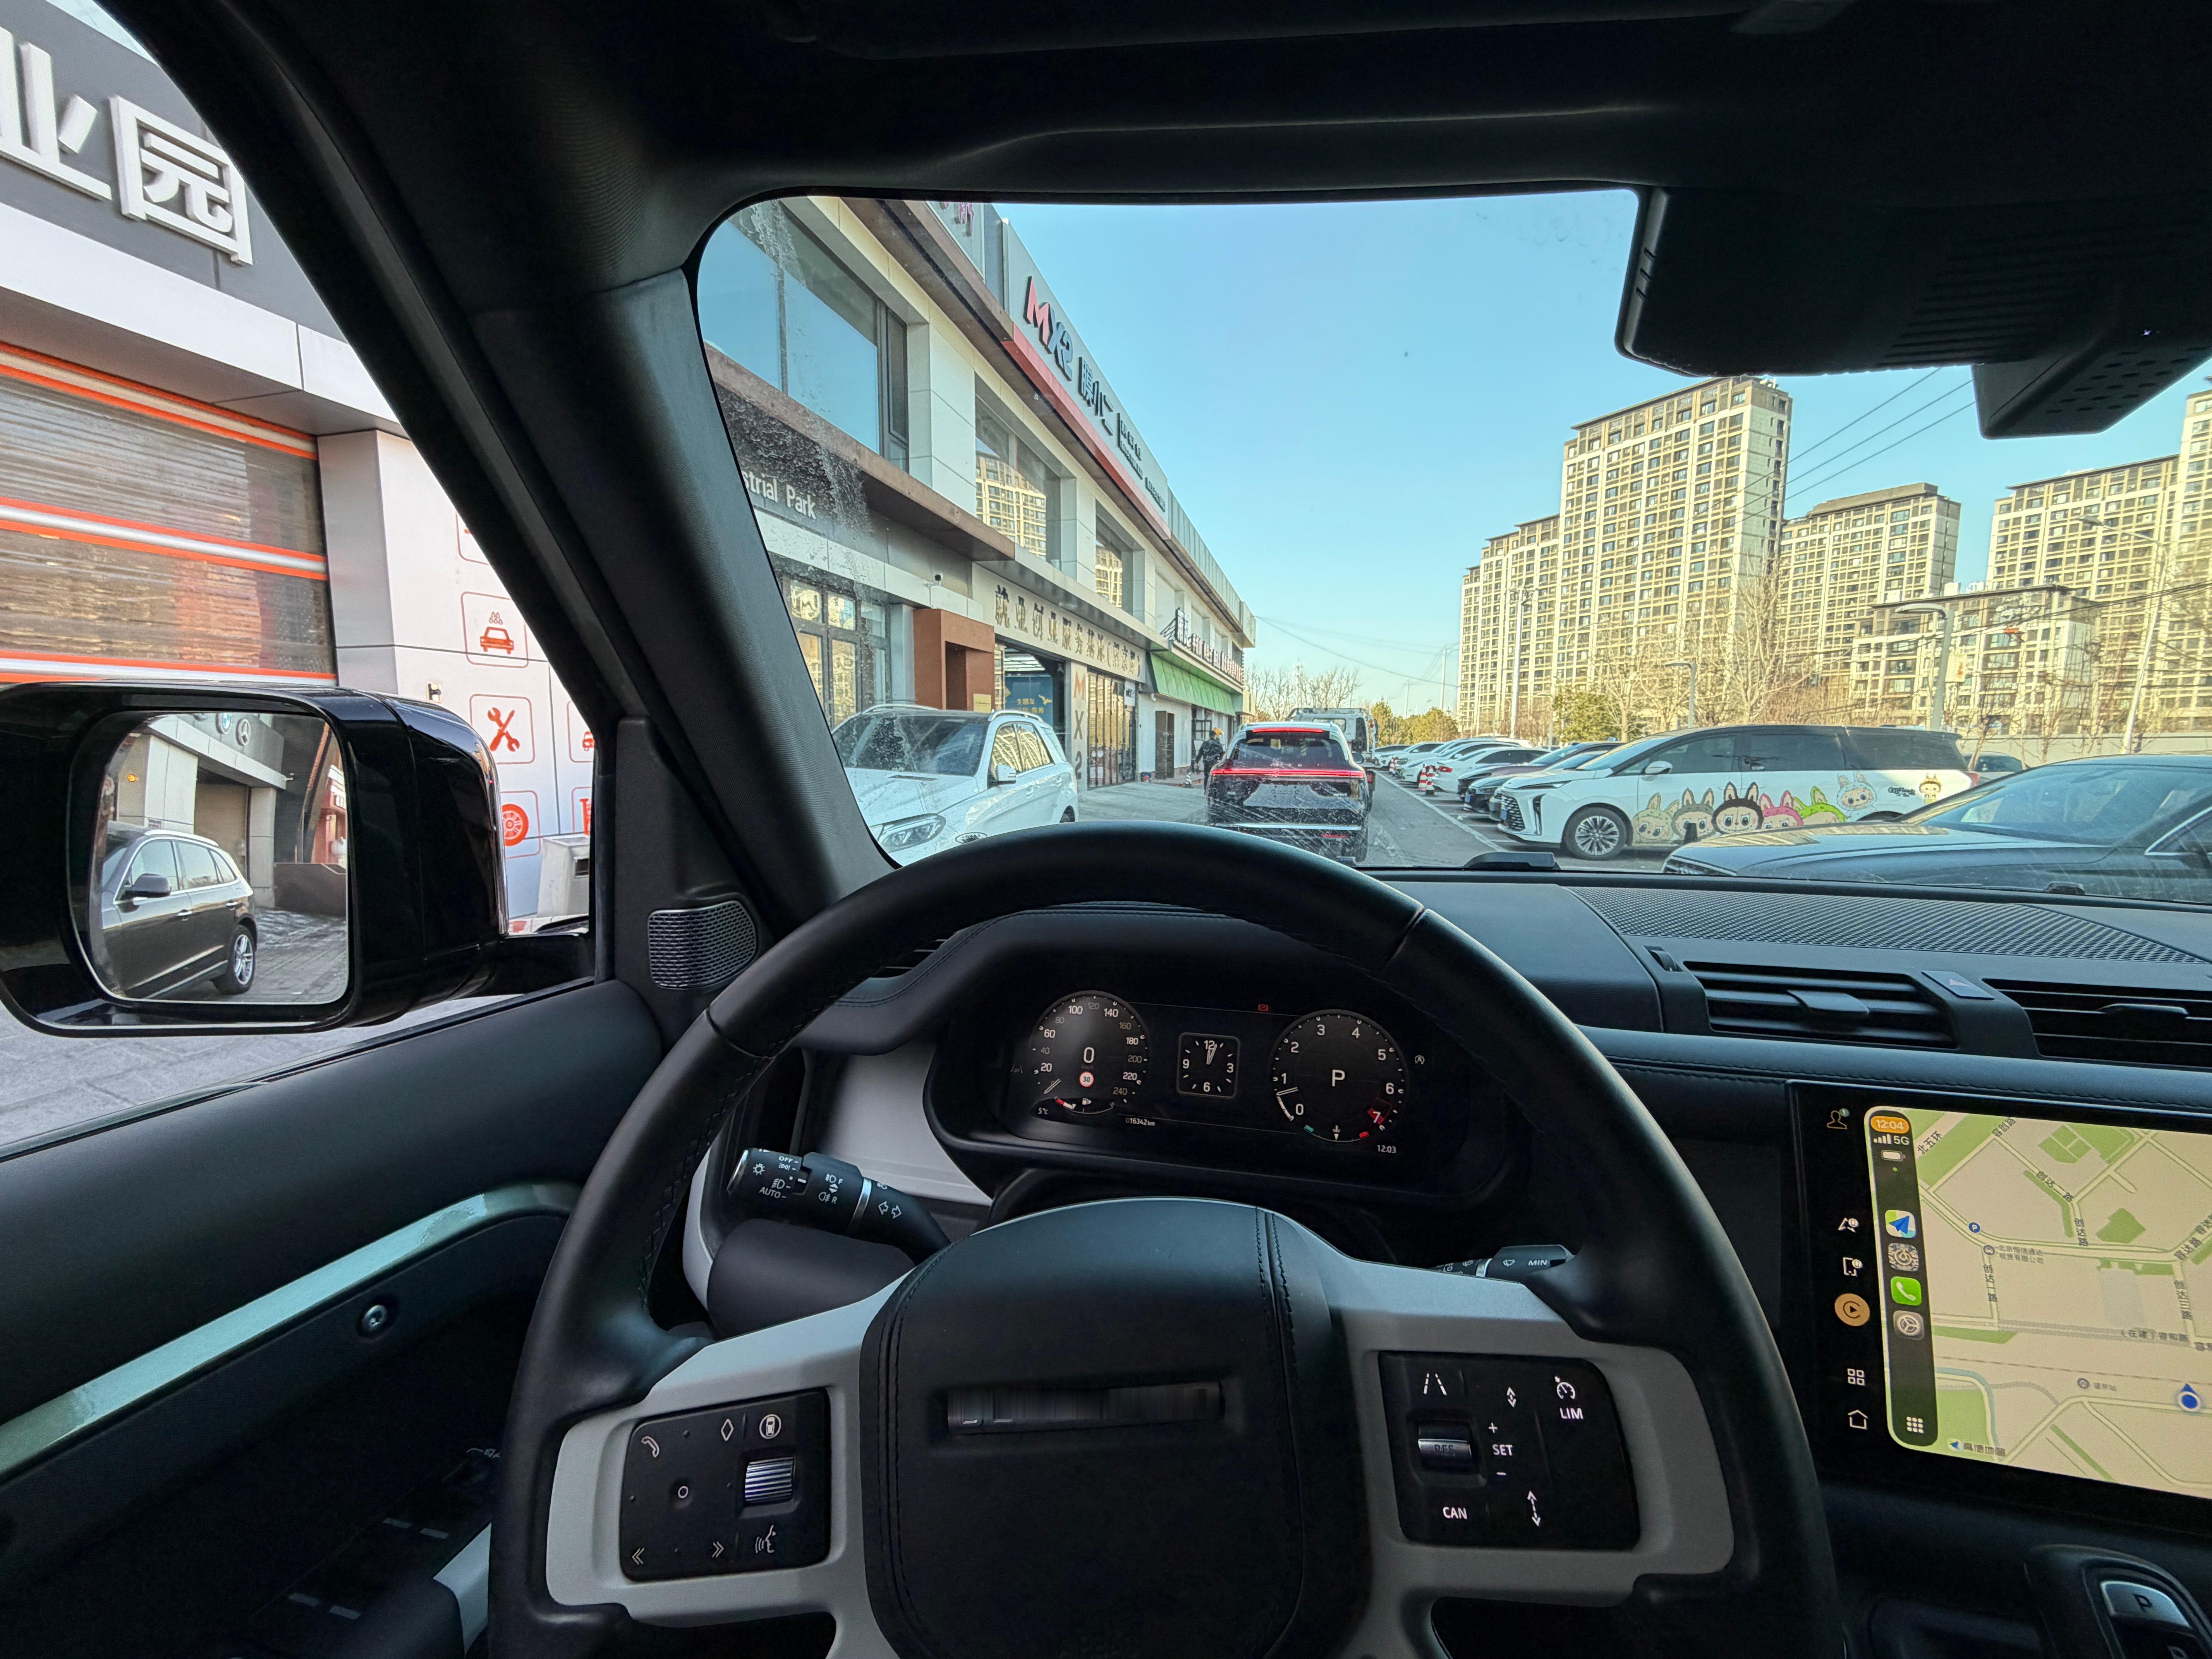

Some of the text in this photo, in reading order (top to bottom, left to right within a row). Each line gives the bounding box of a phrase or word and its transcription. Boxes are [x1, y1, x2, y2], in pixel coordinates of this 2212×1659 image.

[786, 484, 816, 519] Park
[1068, 1005, 1083, 1015] 100
[1104, 1008, 1118, 1018] 140
[1044, 1029, 1056, 1038] 60
[1317, 1024, 1325, 1036] 3
[1352, 1027, 1360, 1039] 4
[1126, 1037, 1139, 1045] 180
[1204, 1040, 1215, 1050] 12
[1291, 1041, 1299, 1053] 2
[1084, 1047, 1095, 1063] 0
[1128, 1055, 1142, 1063] 200
[1378, 1049, 1386, 1061] 5
[1041, 1063, 1052, 1072] 20
[1183, 1059, 1189, 1069] 9
[1226, 1063, 1234, 1073] 3
[1123, 1072, 1137, 1080] 220
[1281, 1073, 1287, 1084] 1
[1332, 1070, 1345, 1087] P
[1113, 1087, 1128, 1095] 240
[1203, 1082, 1211, 1092] 6
[1386, 1083, 1394, 1094] 6
[1295, 1104, 1304, 1115] 0
[1372, 1111, 1381, 1123] 7
[1875, 1119, 1904, 1130] 12:04
[1893, 1136, 1910, 1145] 5G
[1917, 1130, 1943, 1154] 北五环
[1377, 1145, 1396, 1154] 12:03
[759, 1187, 781, 1199] AUTO
[1559, 1407, 1584, 1420] LIM
[1492, 1444, 1513, 1456] SET
[1443, 1506, 1468, 1519] CAN
[2133, 1593, 2152, 1613] P
